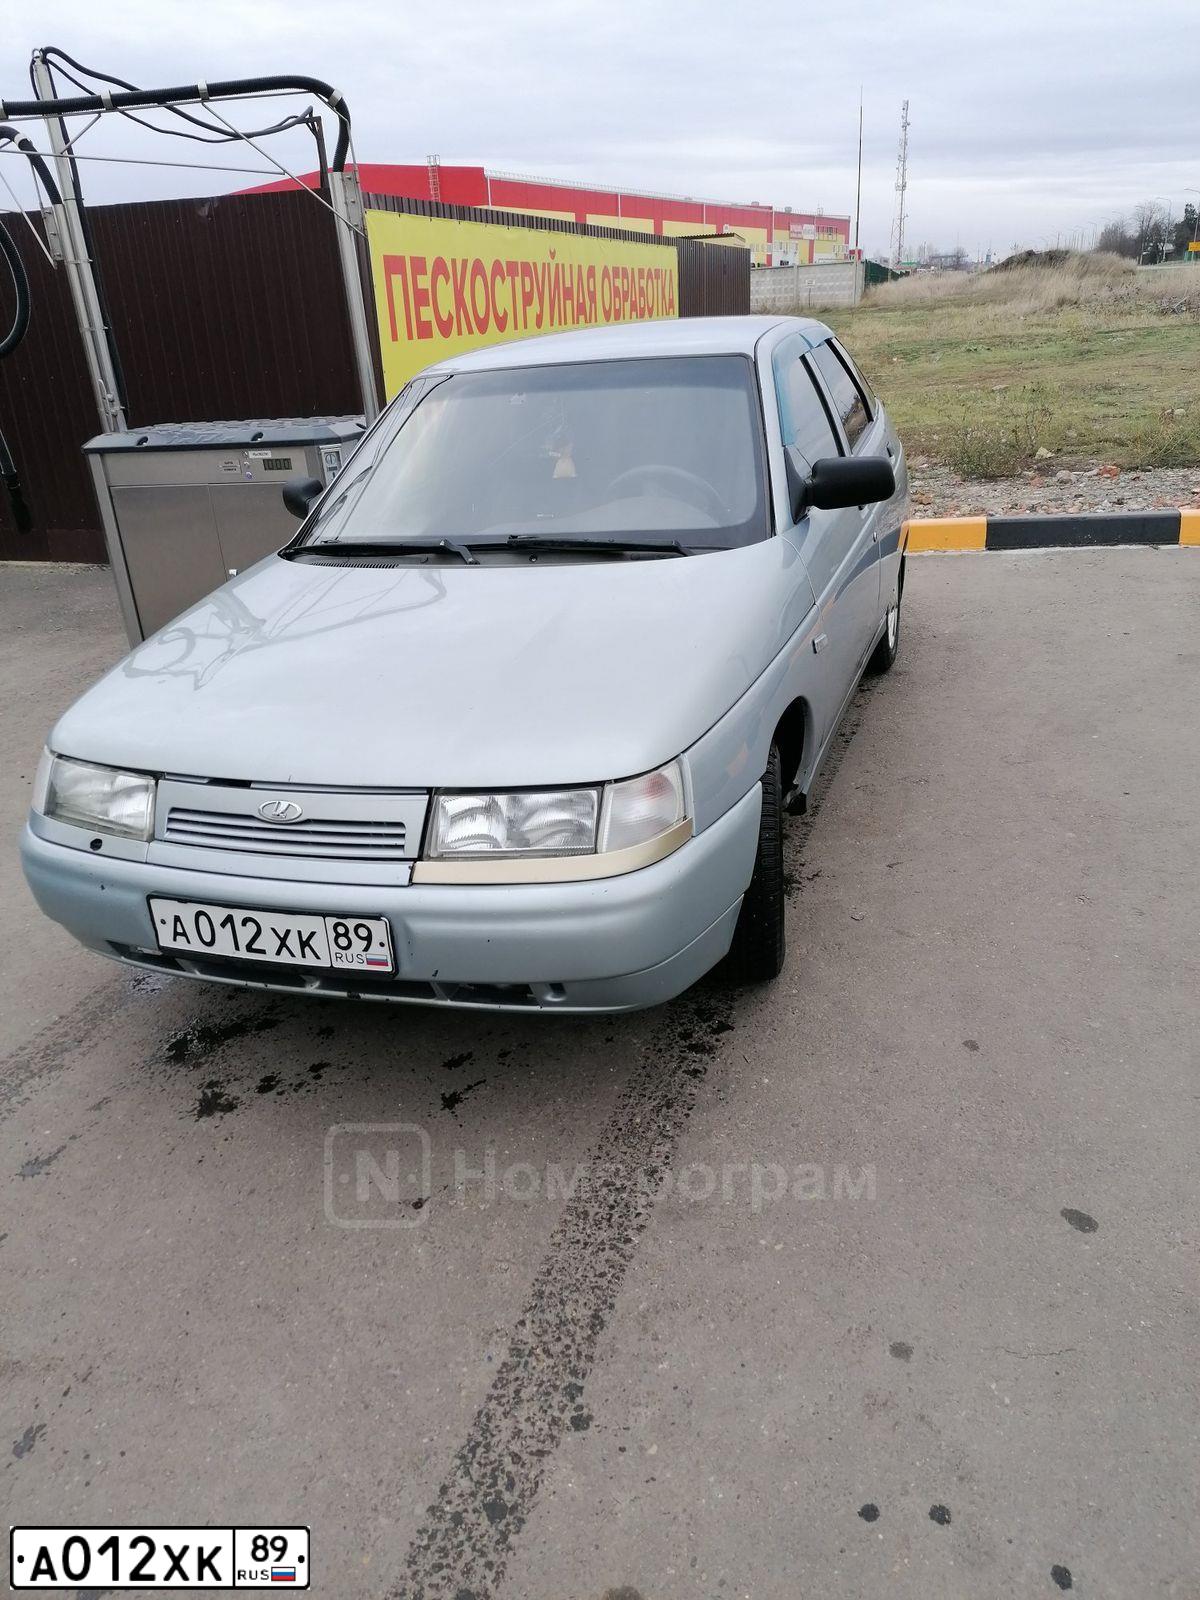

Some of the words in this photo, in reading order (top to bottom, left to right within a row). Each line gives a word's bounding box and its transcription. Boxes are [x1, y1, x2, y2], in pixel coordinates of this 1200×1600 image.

[383, 248, 598, 342] ПЕСКОСТРУЙНАЯ
[601, 264, 676, 322] ОБРАБОТКА
[172, 909, 321, 960] А012ХК
[332, 921, 373, 952] 89
[335, 951, 365, 965] RUS
